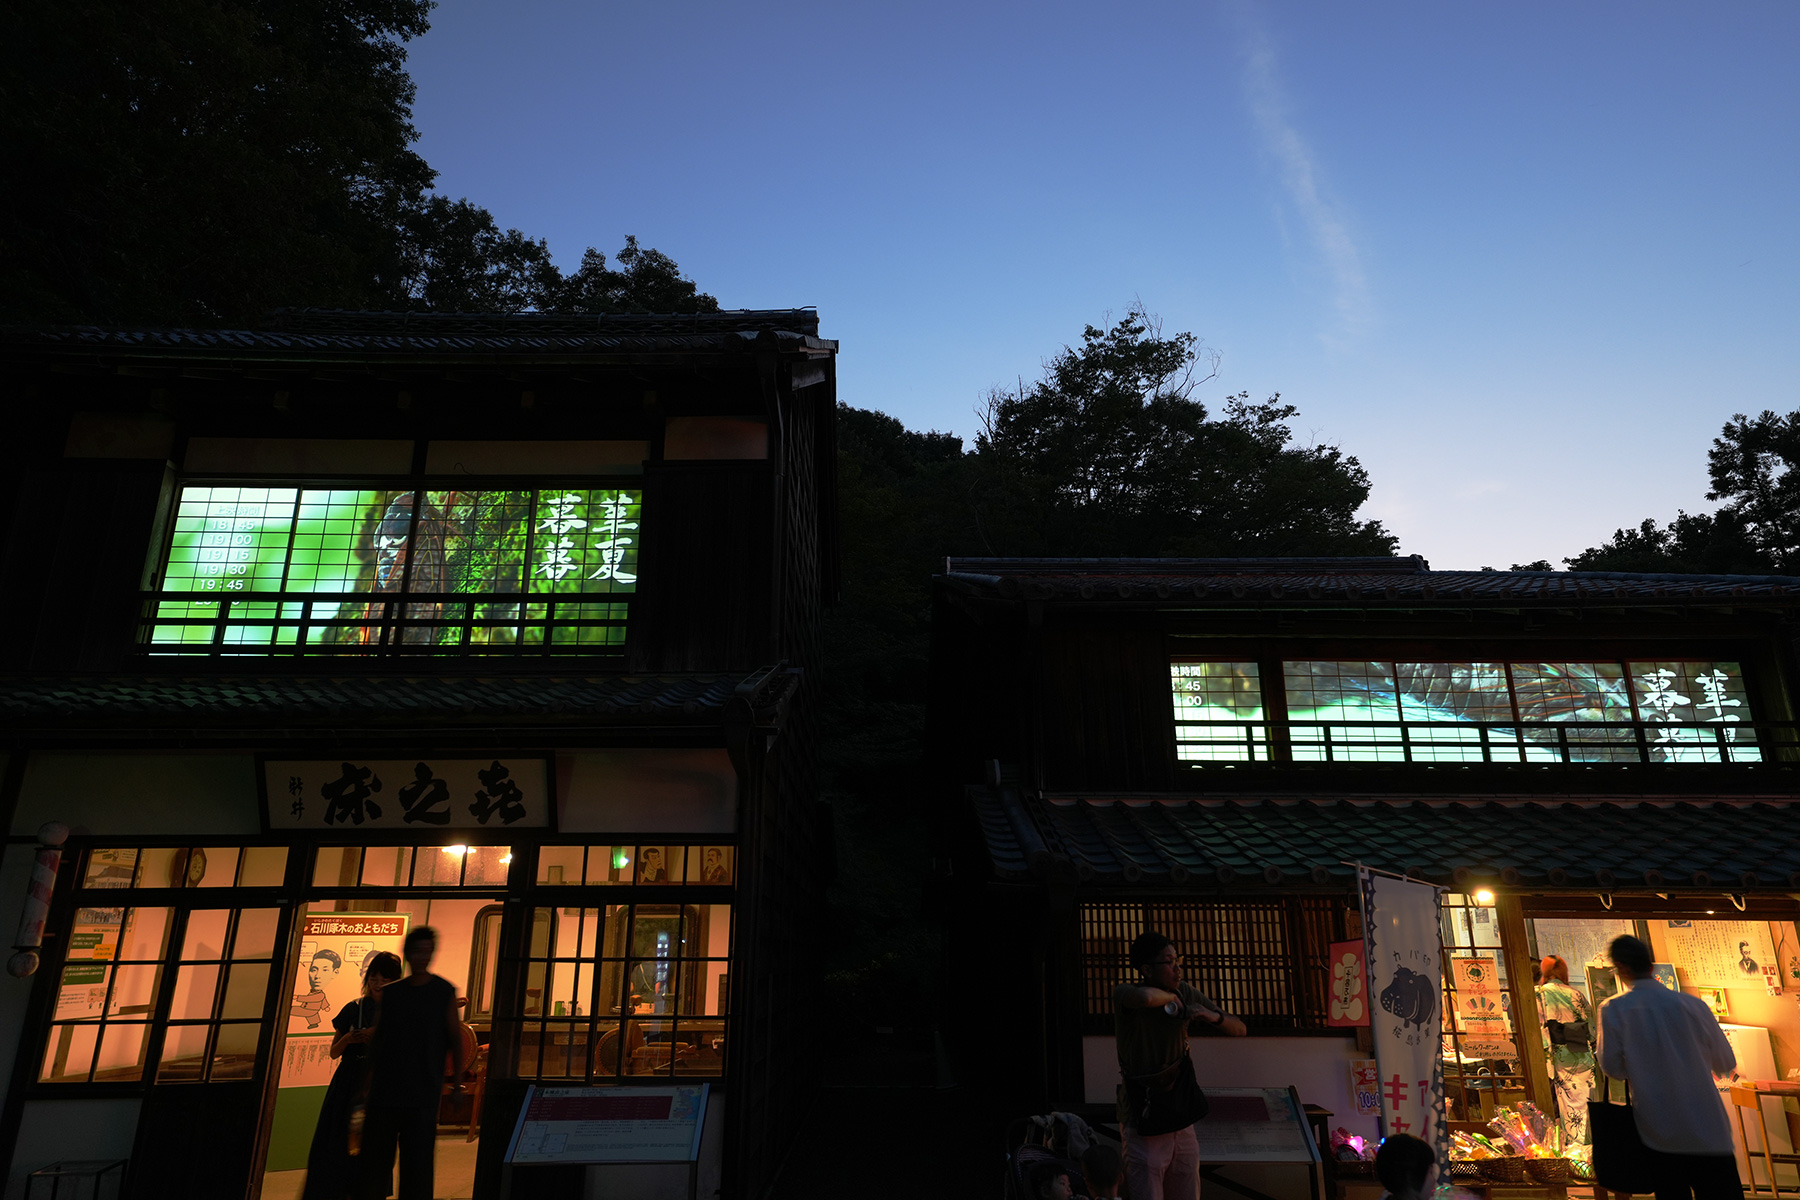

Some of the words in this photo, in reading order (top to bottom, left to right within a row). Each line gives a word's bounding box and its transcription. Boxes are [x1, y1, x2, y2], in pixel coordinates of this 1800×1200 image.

[213, 520, 254, 530] 1845
[209, 534, 252, 545] 1900
[207, 549, 250, 560] 1915
[200, 579, 243, 590] 19:45
[310, 922, 398, 934] 石川啄木のおともだち
